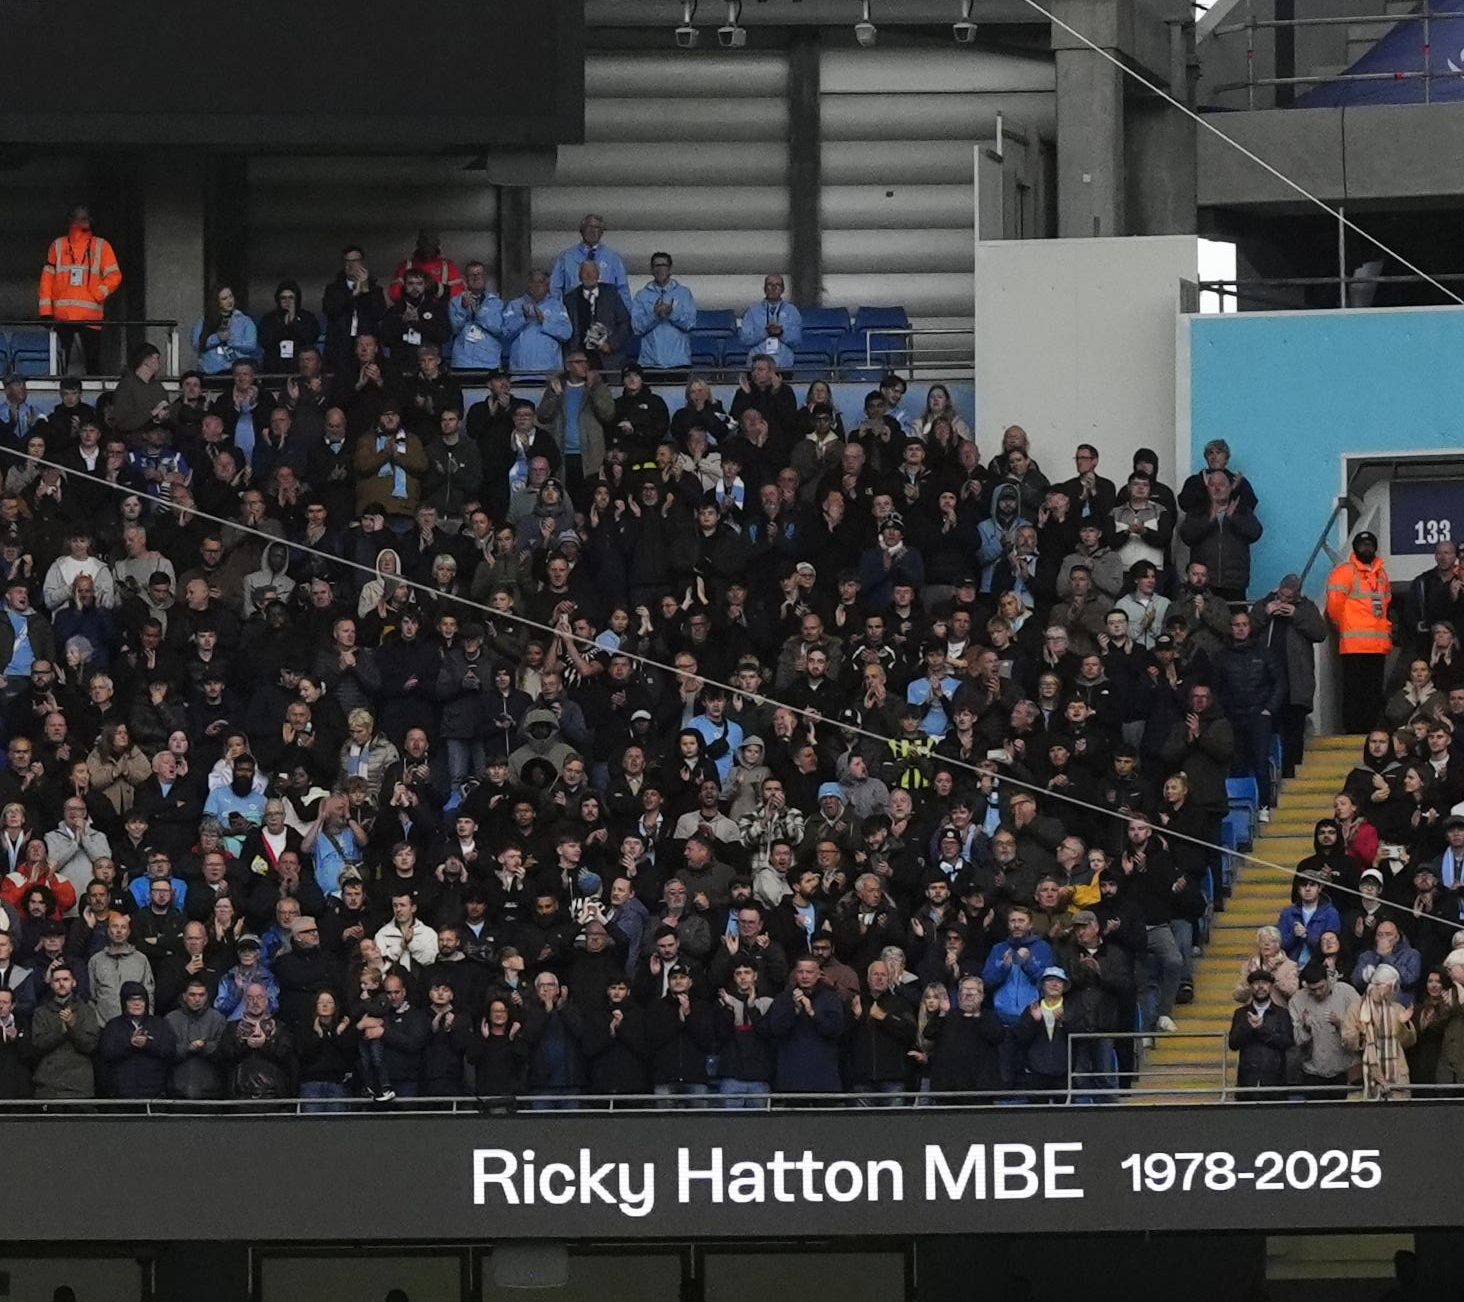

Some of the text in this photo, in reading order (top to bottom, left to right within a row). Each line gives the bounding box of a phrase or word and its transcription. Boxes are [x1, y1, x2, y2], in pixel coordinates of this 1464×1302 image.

[1414, 519, 1452, 545] 133
[473, 1142, 1383, 1217] Ricky Hatton MBE 1978-2025
